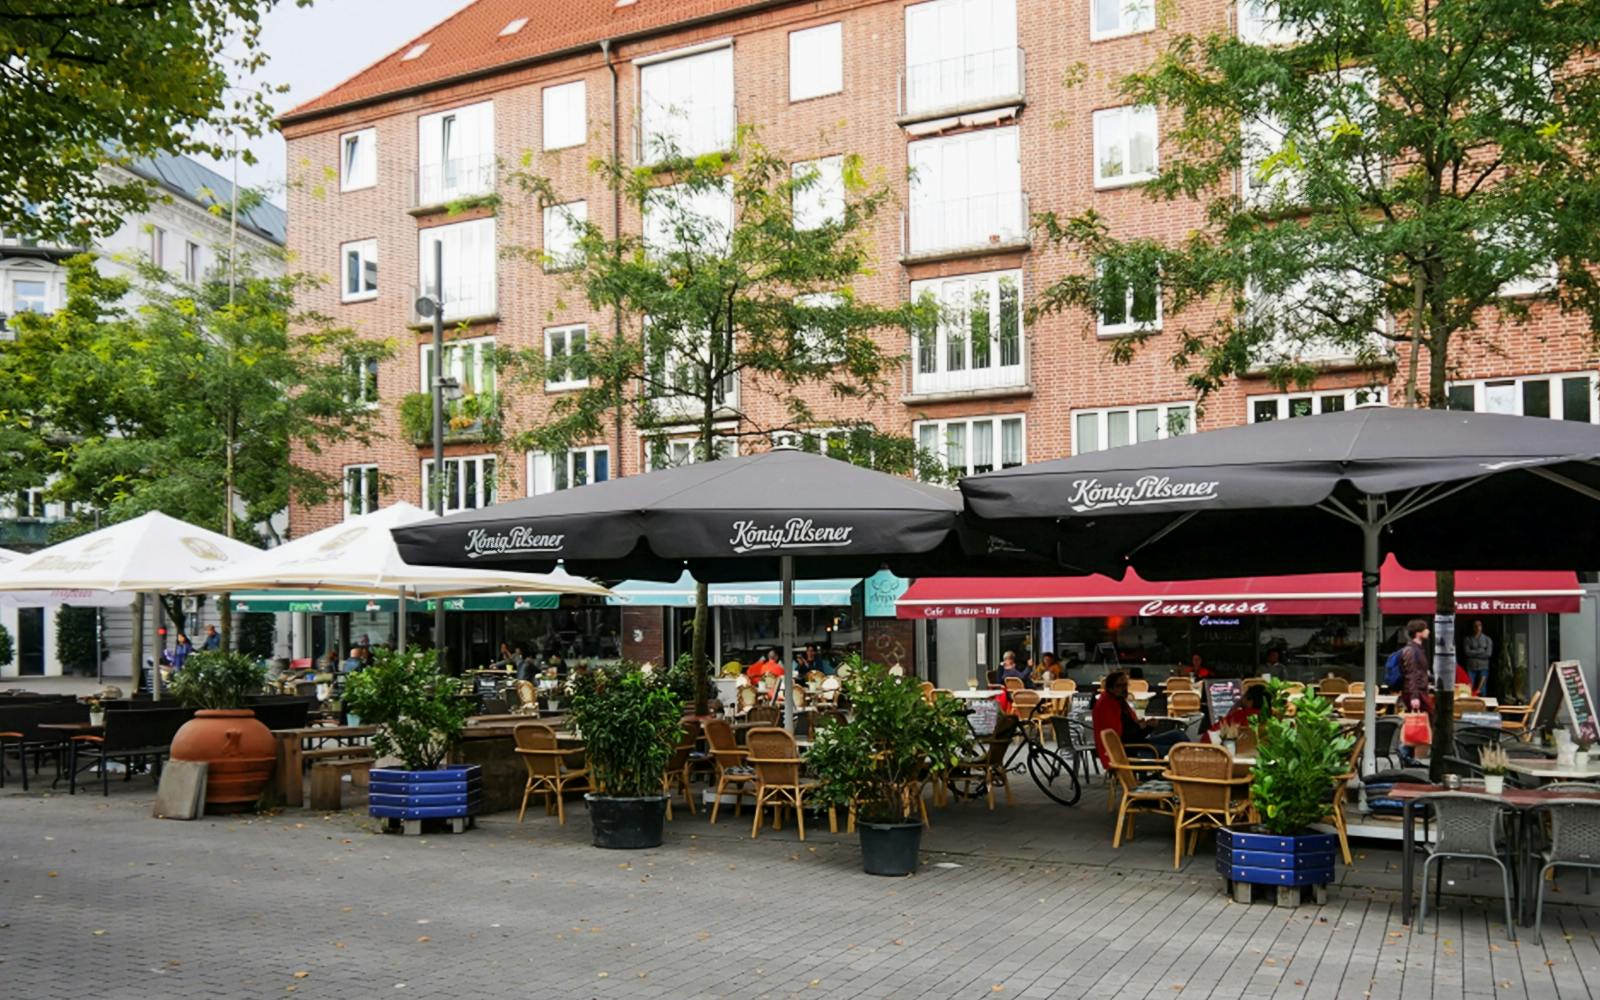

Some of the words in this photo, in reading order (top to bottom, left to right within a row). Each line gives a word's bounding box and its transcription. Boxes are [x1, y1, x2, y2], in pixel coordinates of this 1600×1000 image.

[1067, 478, 1135, 506] König
[1131, 475, 1220, 500] Pilsener
[464, 528, 509, 554] König
[507, 526, 565, 548] Pilsener
[730, 520, 784, 548] König
[782, 517, 854, 543] Pilsener
[1139, 599, 1269, 617] Curiousa
[1492, 600, 1537, 610] Pizzeria
